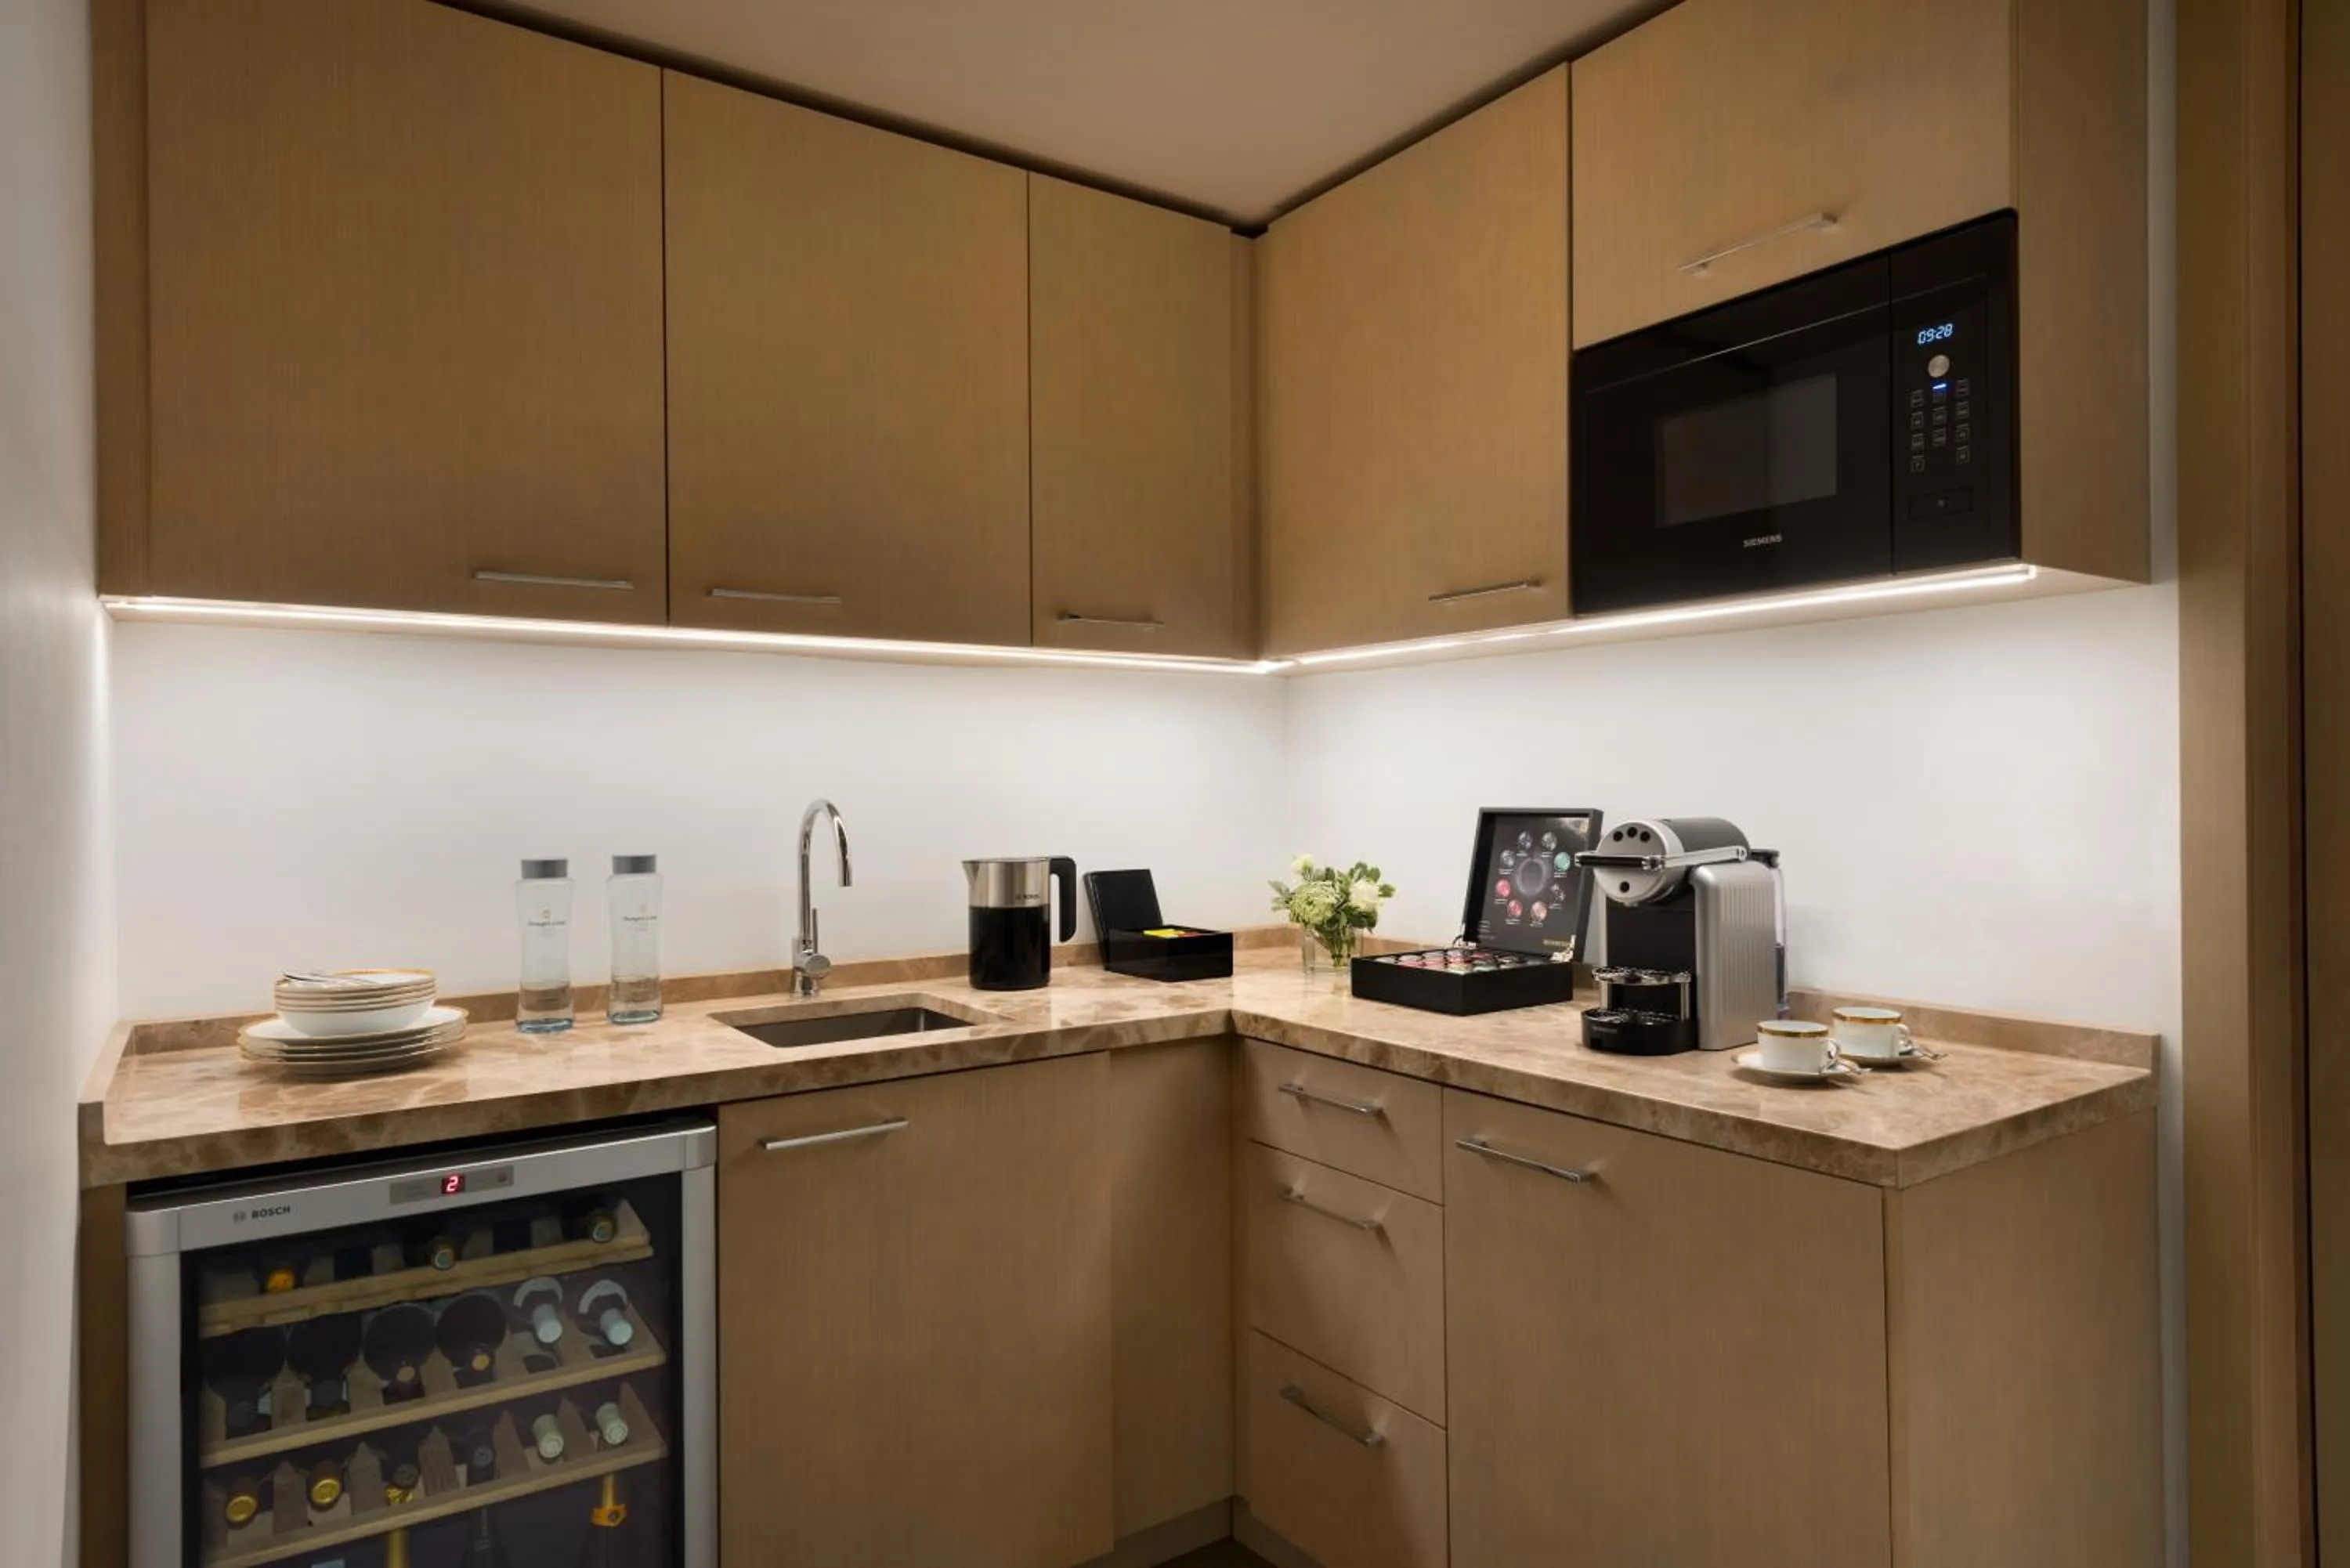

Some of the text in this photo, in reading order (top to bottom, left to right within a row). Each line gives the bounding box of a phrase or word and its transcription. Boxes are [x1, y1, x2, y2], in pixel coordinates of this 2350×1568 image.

[1918, 323, 1954, 345] 09:28
[1742, 533, 1783, 548] SIEMENS
[446, 1175, 459, 1192] 2
[251, 1205, 291, 1219] BOSCH
